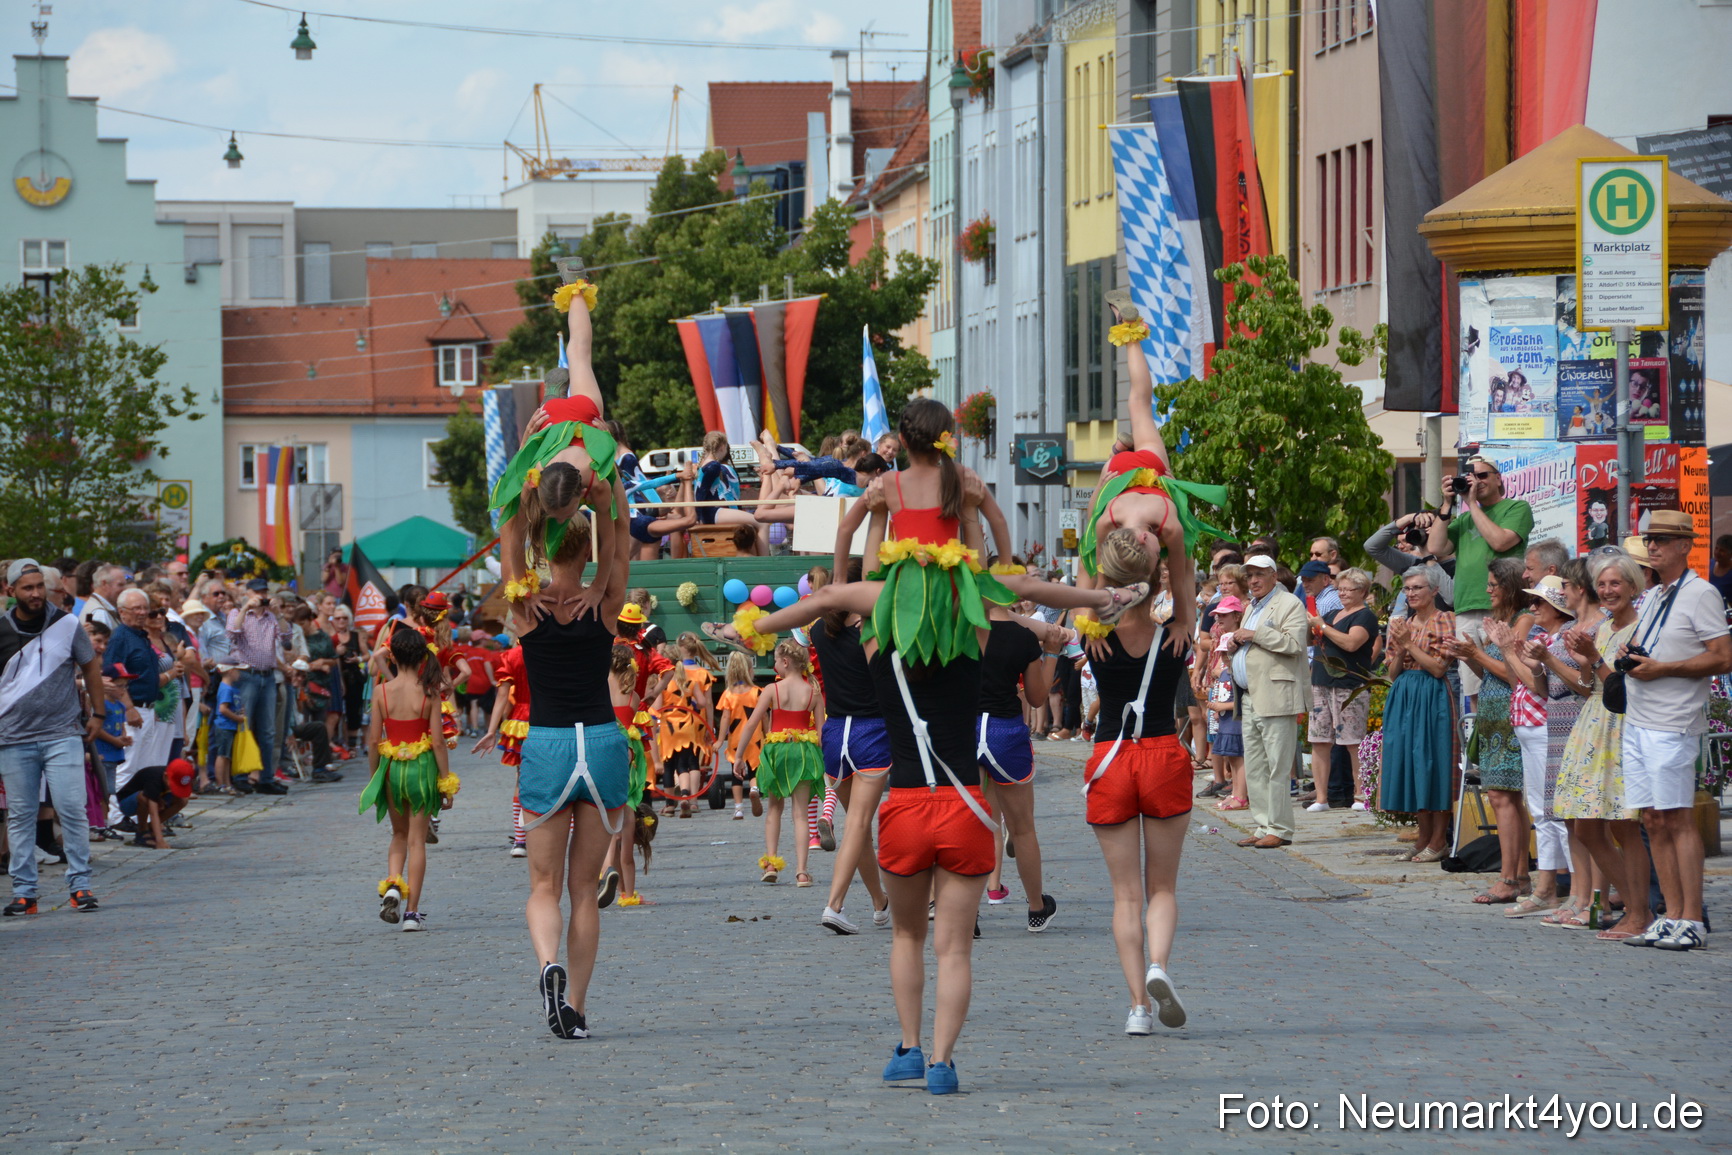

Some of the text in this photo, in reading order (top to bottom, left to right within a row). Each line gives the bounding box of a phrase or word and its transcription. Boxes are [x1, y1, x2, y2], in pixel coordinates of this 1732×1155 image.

[1606, 184, 1638, 221] H
[1593, 242, 1651, 254] Marktplatz
[1500, 353, 1515, 364] und
[1683, 465, 1708, 477] Neumar
[1539, 522, 1564, 533] Lavendel
[1537, 533, 1548, 541] Ove
